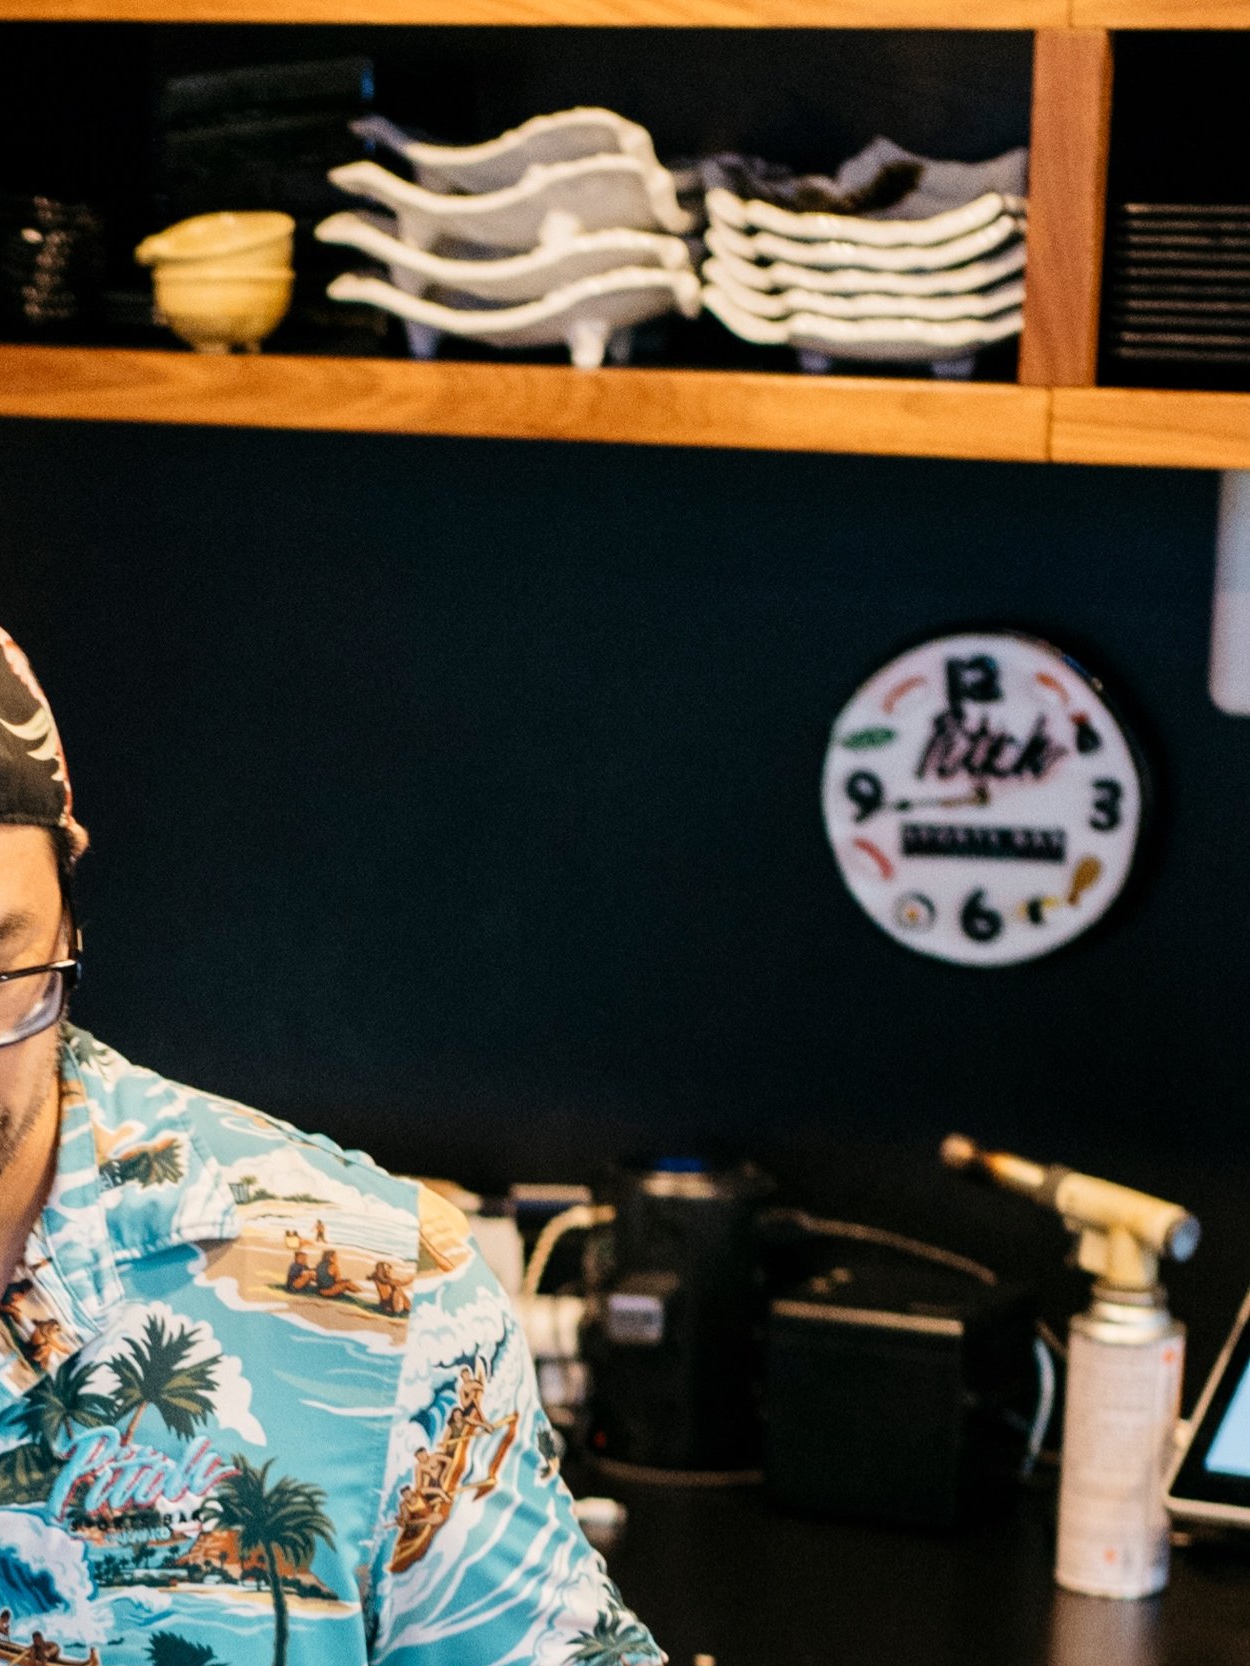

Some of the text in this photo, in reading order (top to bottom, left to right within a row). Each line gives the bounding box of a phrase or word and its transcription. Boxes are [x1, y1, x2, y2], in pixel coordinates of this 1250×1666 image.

[846, 769, 884, 824] 9
[1089, 776, 1121, 833] 3
[960, 887, 1003, 942] 6
